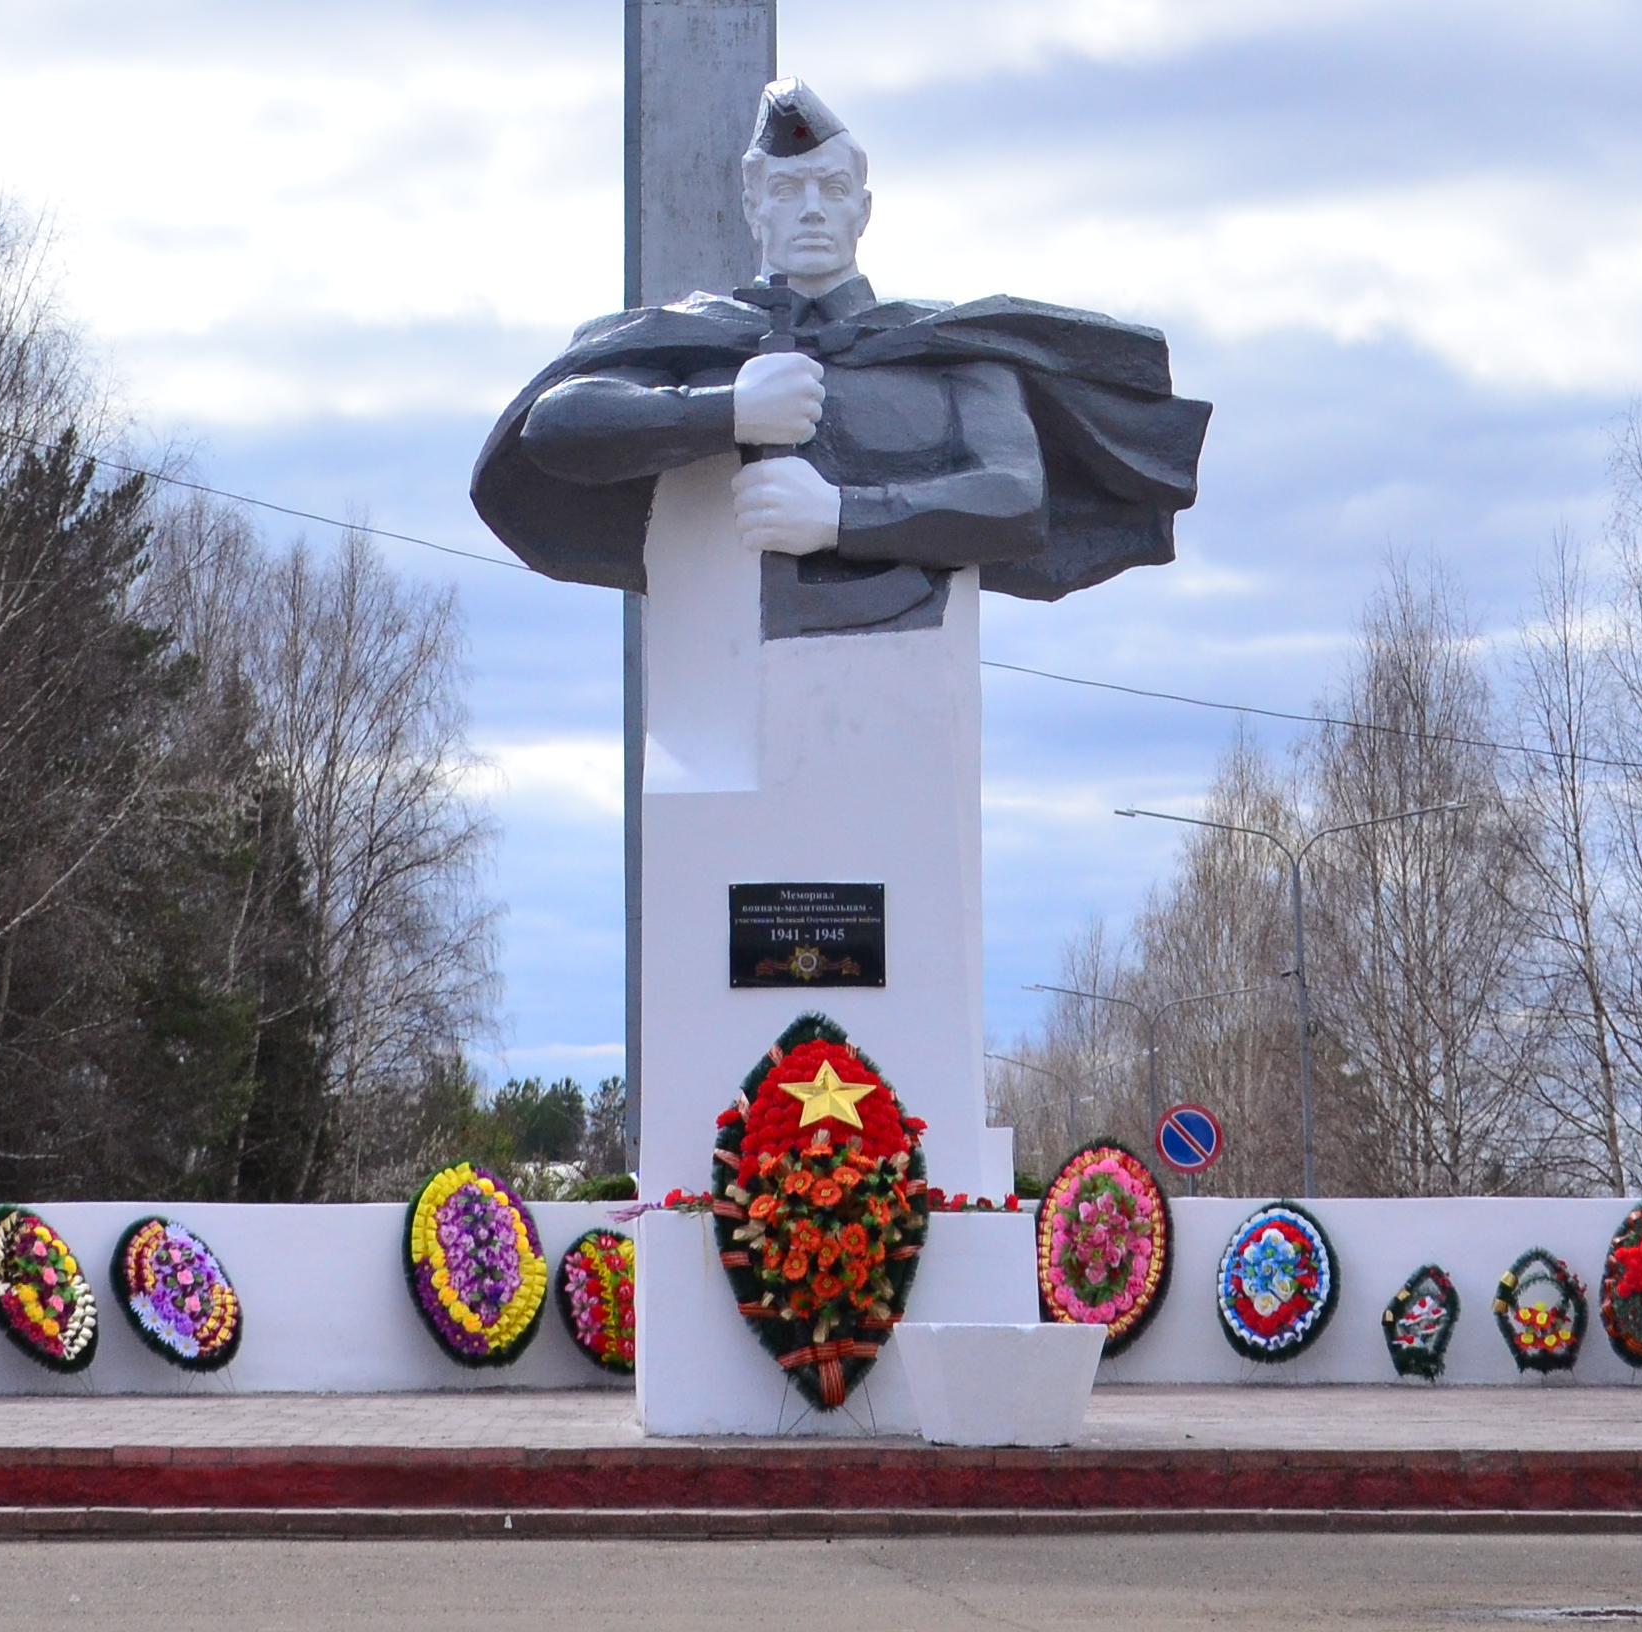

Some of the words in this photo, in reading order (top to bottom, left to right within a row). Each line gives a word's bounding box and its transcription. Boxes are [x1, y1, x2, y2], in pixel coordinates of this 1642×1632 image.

[780, 889, 835, 902] Мемориал
[776, 916, 805, 924] Великой
[806, 915, 857, 924] Отечественной
[858, 915, 881, 924] войны
[770, 928, 799, 941] 1941
[815, 928, 845, 941] 1945
